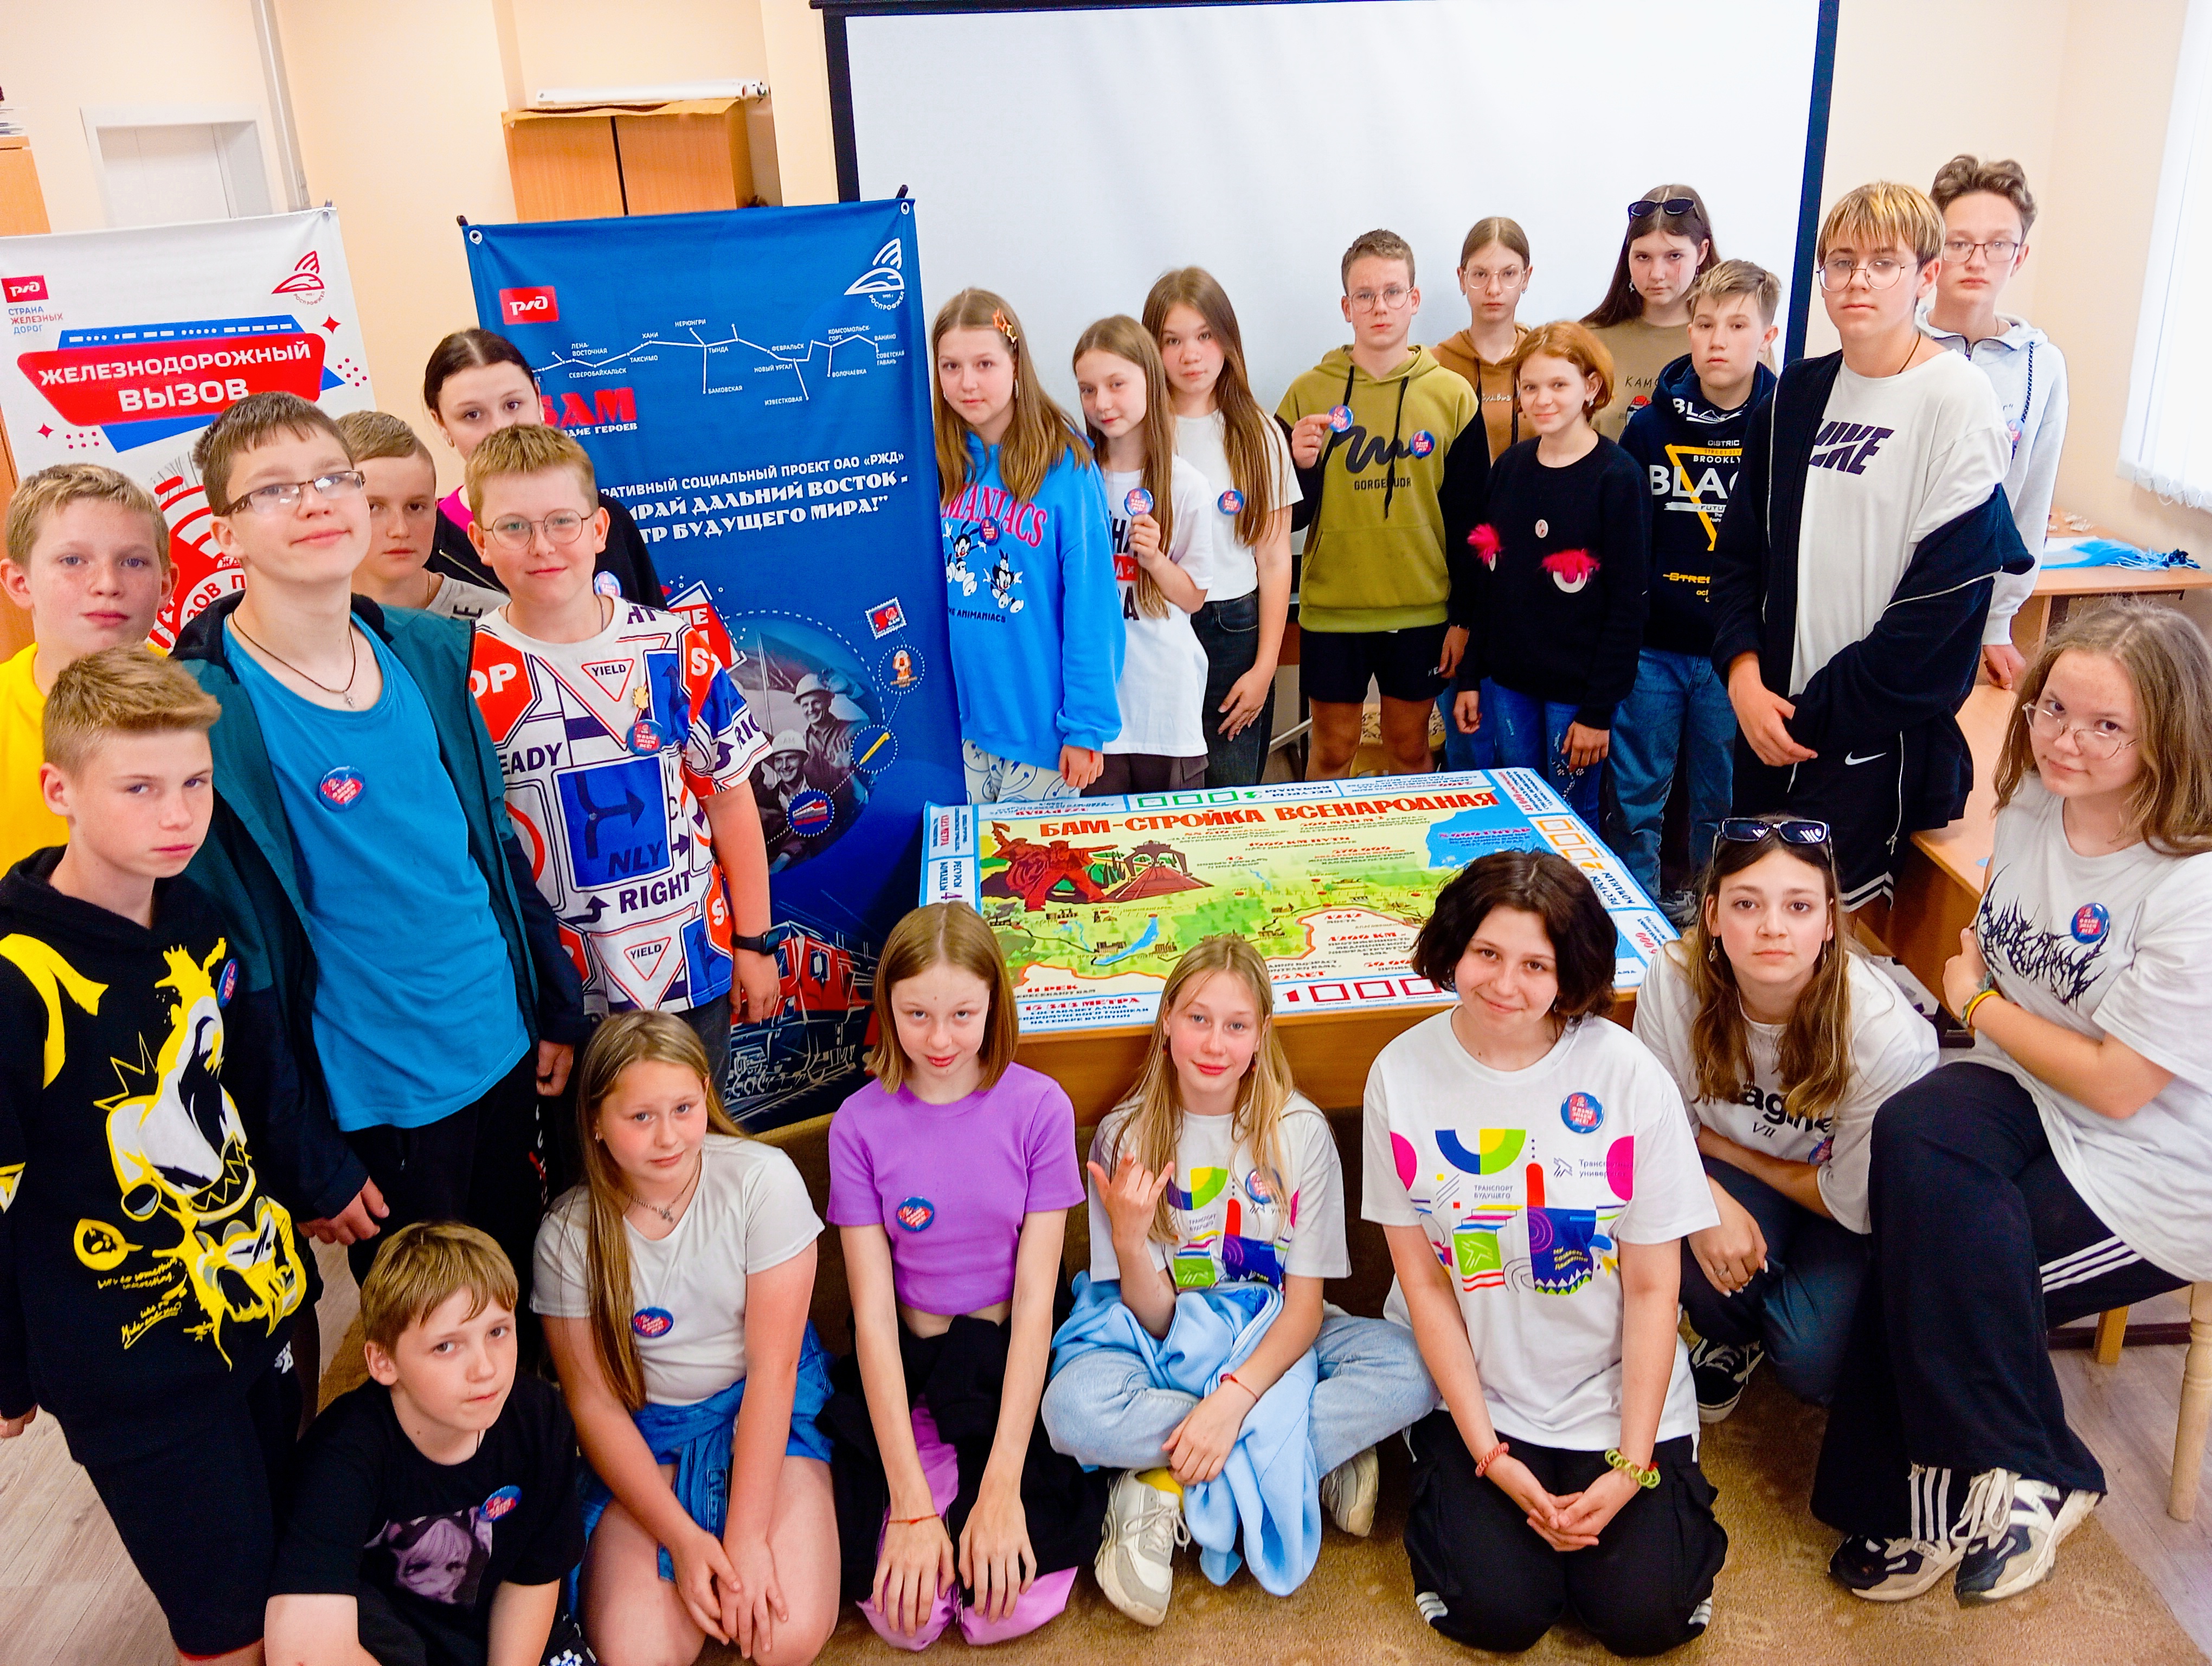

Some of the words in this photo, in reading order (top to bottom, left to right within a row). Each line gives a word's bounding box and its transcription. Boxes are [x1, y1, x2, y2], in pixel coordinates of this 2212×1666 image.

[8, 306, 44, 315] СТРАНА
[10, 313, 63, 324] ЖЕЛЕЗНЫХ
[674, 319, 706, 327] НЕРЮНГРИ
[14, 325, 43, 335] ДОРОГ
[572, 348, 608, 356] ВОСТОЧНАЯ
[771, 343, 805, 351] ФЕВРАЛЬСК
[629, 355, 658, 363] ТАКСИМО
[876, 350, 905, 359] СОВЕТСКАЯ
[38, 340, 311, 386] ЖЕЛЕЗНОДОРОЖНЫЙ
[754, 364, 774, 373] НОВЫЙ
[569, 368, 627, 379] СЕВЕРОБАЙКАЛЬСК
[832, 368, 867, 377] ВОЛОЧАЕВКА
[118, 379, 249, 412] ВЫЗОВ
[708, 386, 743, 394] БАМОВСКАЯ
[764, 396, 803, 406] ИЗВЕСТКОВАЯ
[595, 422, 638, 434] ГЕРОЕВ
[681, 465, 777, 490] СОЦИАЛЬНЫЙ
[781, 460, 830, 477] ПРОЕКТ
[833, 456, 860, 470] ОАО
[864, 451, 904, 466] «РЖД»
[691, 480, 804, 516] ДАЛЬНИЙ
[808, 471, 897, 497] ВОСТОК
[672, 507, 807, 540] БУДУЩЕГО
[957, 609, 1006, 624] ANIMANIACS
[591, 664, 626, 676] YIELD
[1274, 790, 1500, 821] ВСЕНАРОДНАЯ
[608, 840, 664, 877] NLY
[619, 872, 691, 914] RIGHT
[630, 944, 662, 959] YIELD
[1283, 989, 1300, 1002] 1
[1082, 997, 1140, 1007] МЕТРА
